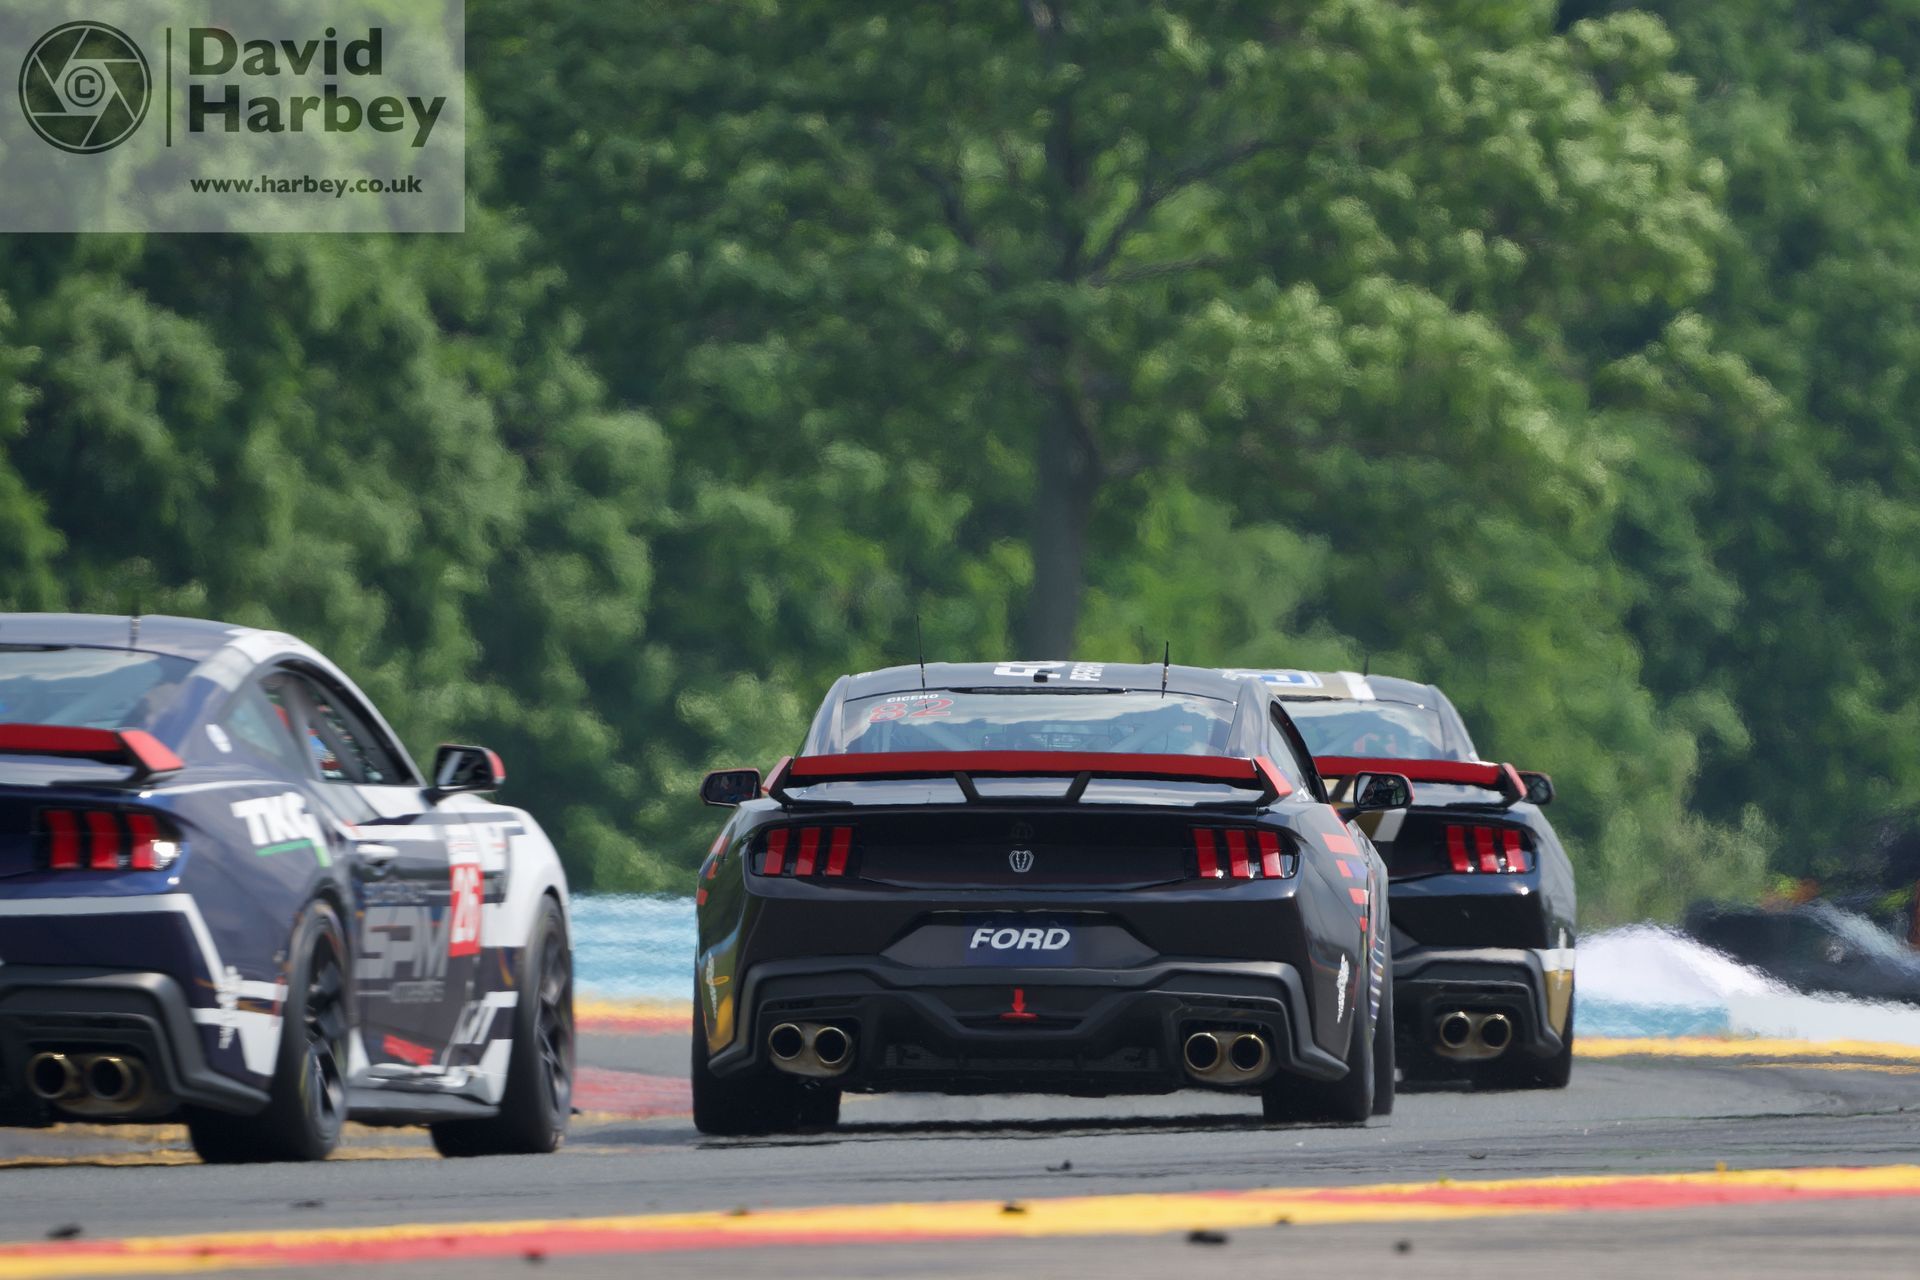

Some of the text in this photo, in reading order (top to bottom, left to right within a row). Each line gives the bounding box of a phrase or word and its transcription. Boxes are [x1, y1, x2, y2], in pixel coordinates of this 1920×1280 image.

[869, 698, 953, 722] 82
[450, 866, 482, 943] 26
[970, 928, 1071, 950] FORD
